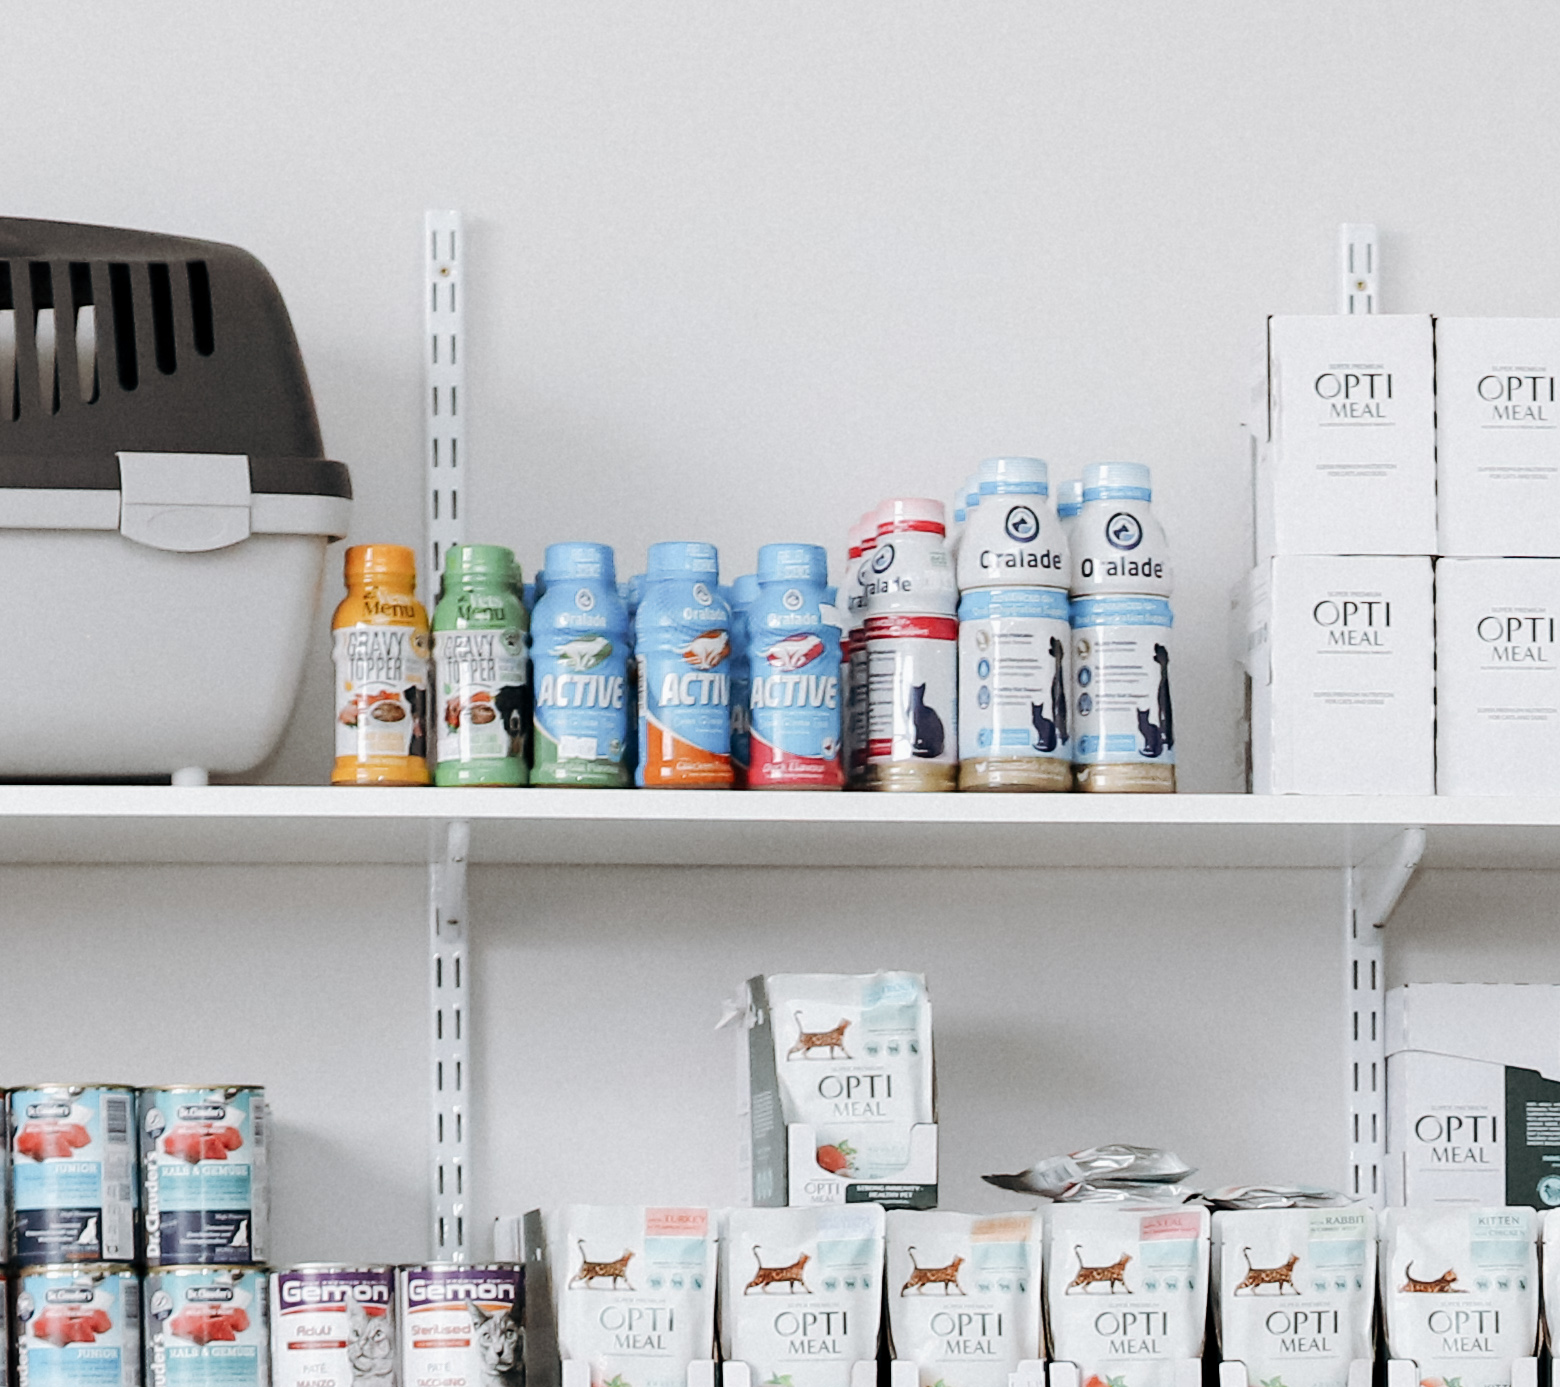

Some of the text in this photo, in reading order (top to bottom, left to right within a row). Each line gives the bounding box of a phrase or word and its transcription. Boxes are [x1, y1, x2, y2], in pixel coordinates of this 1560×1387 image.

[1314, 373, 1392, 400] OPTI
[1330, 401, 1387, 419] MEAL
[1313, 600, 1391, 628] OPTI
[347, 632, 405, 655] GRAVY
[1328, 629, 1384, 647] MEAL
[537, 674, 624, 708] ACTIVE
[750, 675, 837, 709] ACTIVE
[817, 1074, 892, 1100] OPTI
[833, 1100, 887, 1117] MEAL
[1414, 1114, 1497, 1143] OPTI
[1432, 1146, 1490, 1164] MEAL
[1478, 1215, 1519, 1226] KITTEN
[282, 1280, 389, 1303] Gemon
[408, 1279, 516, 1302] Gemon
[296, 1325, 332, 1337] Adult
[599, 1306, 675, 1333] OPTI
[774, 1311, 848, 1337] OPTI
[1265, 1310, 1338, 1335] OPTI
[1427, 1310, 1500, 1335] OPTI
[615, 1334, 667, 1350] MEAL
[788, 1338, 842, 1355] MEAL
[1281, 1336, 1331, 1353] MEAL
[1442, 1337, 1494, 1353] MEAL
